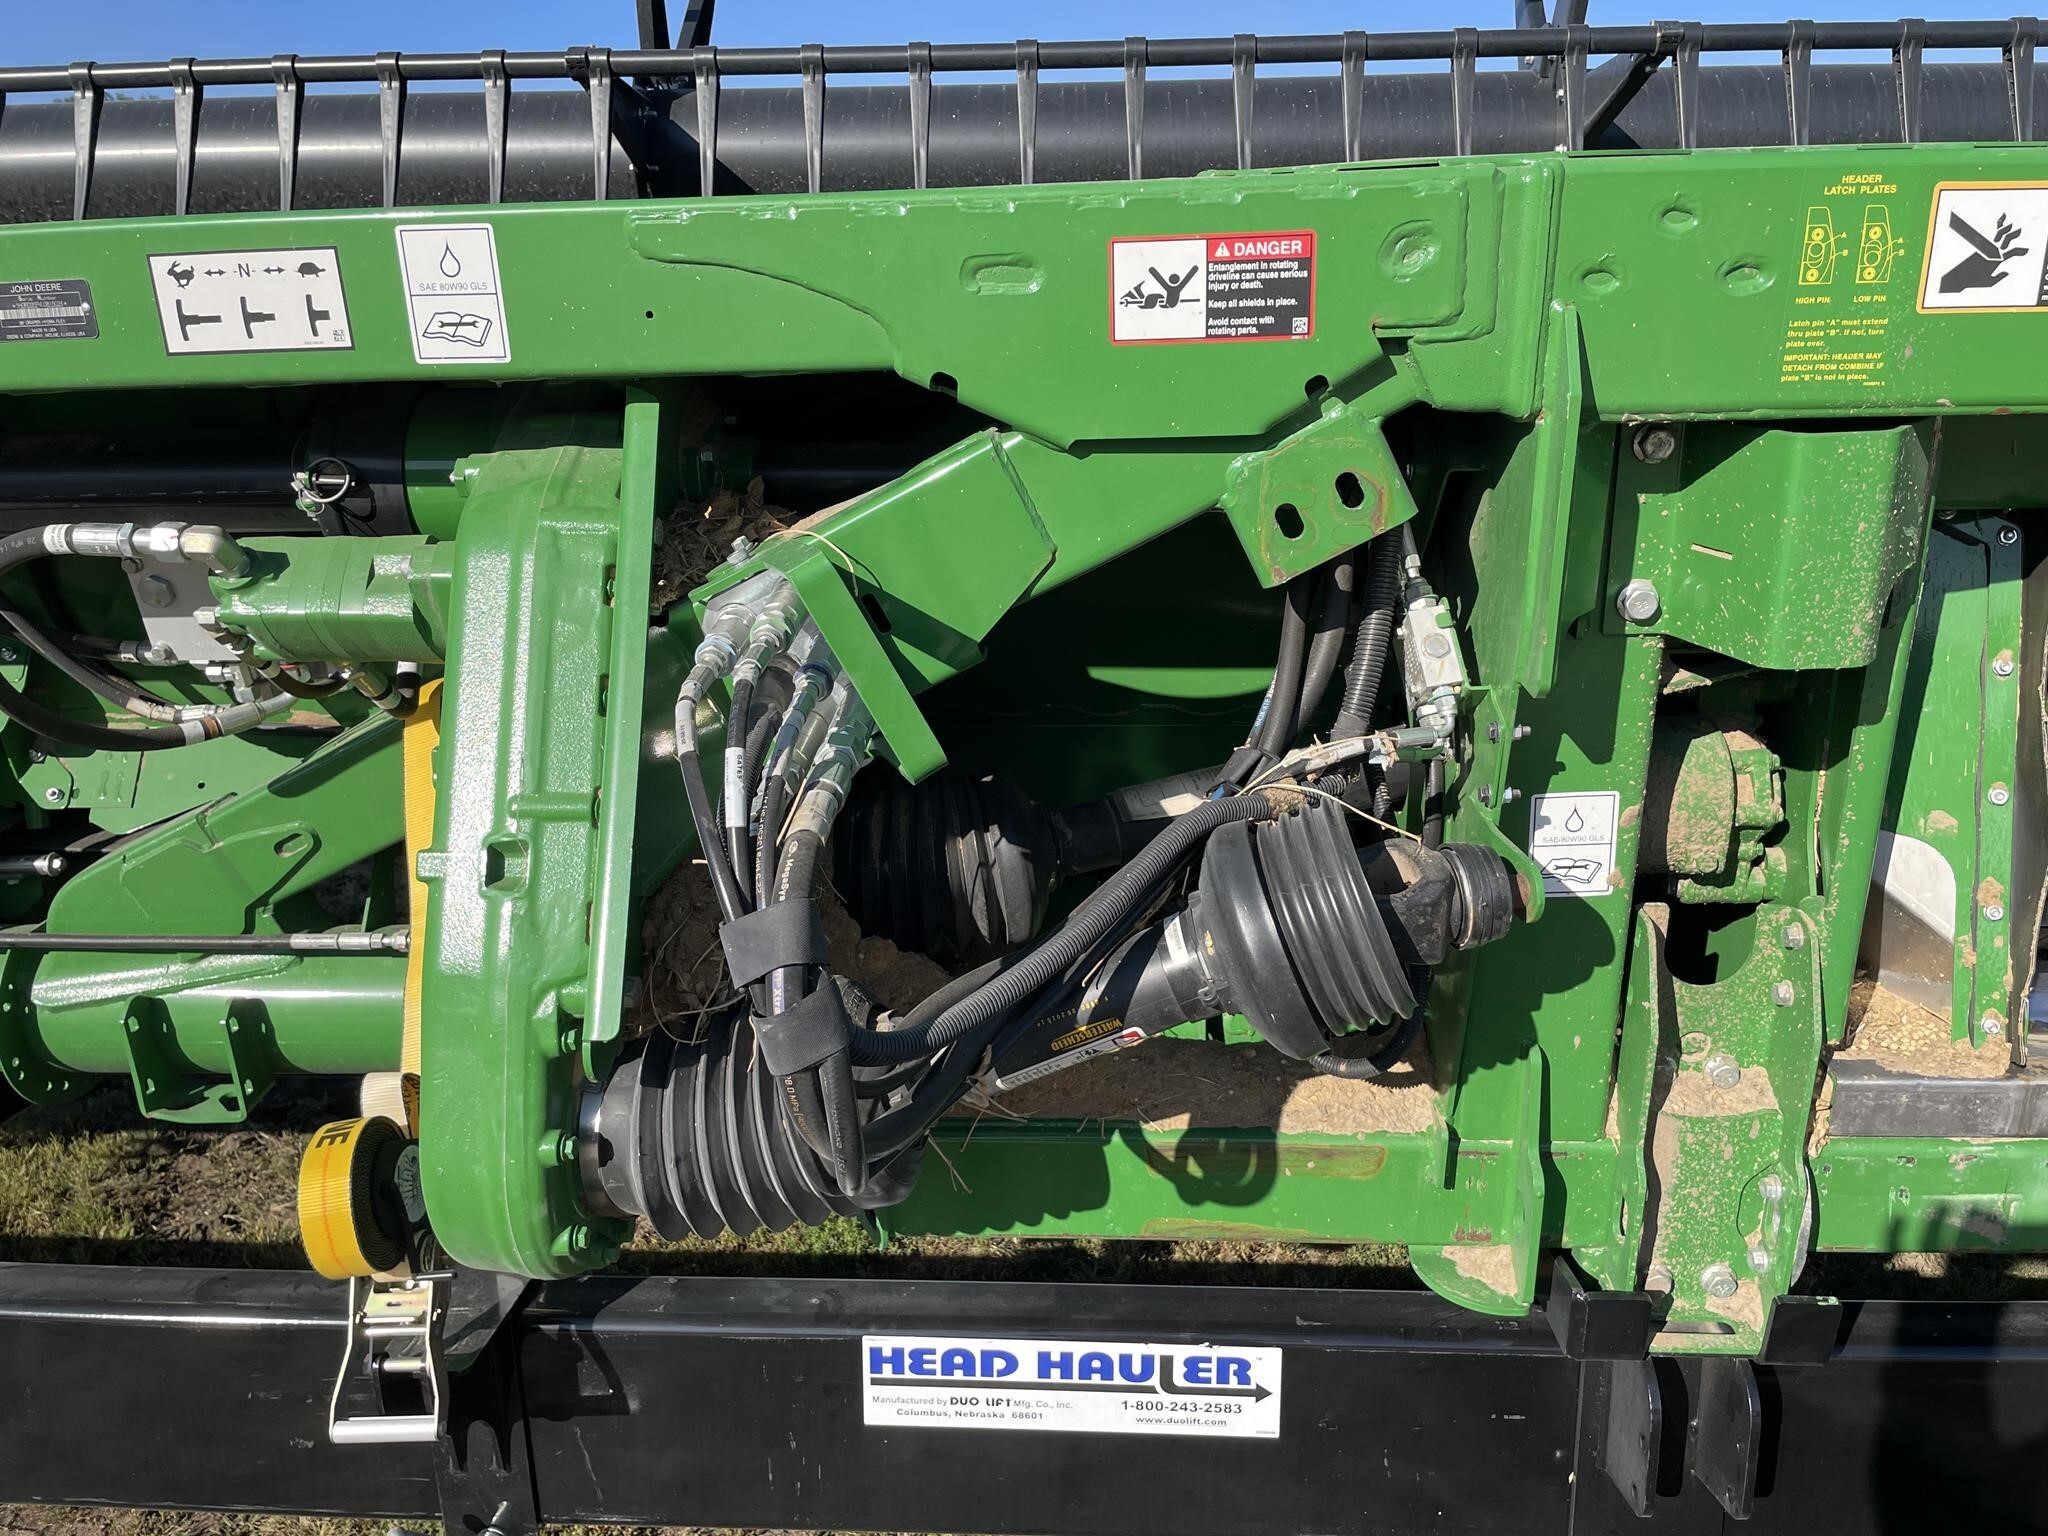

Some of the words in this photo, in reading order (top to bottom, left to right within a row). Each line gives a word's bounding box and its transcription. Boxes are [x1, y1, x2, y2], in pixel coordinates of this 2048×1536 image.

[1841, 174, 1883, 184] HEADER
[1824, 186, 1855, 195] LATCH
[1860, 185, 1897, 194] PLATES
[1234, 240, 1302, 256] DANGER
[1208, 262, 1259, 272] Entanglement
[1260, 261, 1268, 270] in
[1269, 260, 1298, 270] rotating
[1208, 273, 1240, 281] driveline
[1280, 270, 1308, 278] serious
[10, 285, 33, 293] JOHN
[35, 283, 62, 291] DEERE
[419, 283, 437, 291] SAE
[440, 282, 468, 291] 80W90
[470, 282, 487, 290] GL5
[1208, 282, 1229, 292] injury
[1230, 282, 1239, 290] or
[1240, 281, 1263, 289] death.
[1208, 300, 1227, 309] Keep
[1228, 299, 1237, 307] all
[1238, 298, 1265, 307] shields
[1266, 297, 1274, 306] in
[1275, 297, 1298, 307] place.
[1853, 295, 1871, 303] LOW
[1208, 317, 1229, 326] Avoid
[1230, 317, 1258, 325] contact
[1259, 316, 1275, 324] with
[1812, 320, 1825, 328] pin
[1208, 327, 1235, 336] rotating
[1237, 326, 1258, 336] parts.
[1804, 330, 1825, 338] plate
[1785, 340, 1805, 349] plate
[1782, 364, 1813, 372] DETACH
[1781, 375, 1799, 383] plate
[1846, 373, 1869, 381] place.
[1051, 1018, 1123, 1052] WALTERSCHEID
[869, 1346, 1019, 1378] HEAD
[1037, 1351, 1251, 1386] HAULER
[872, 1395, 934, 1406] Manufactured
[936, 1397, 948, 1407] by
[950, 1397, 980, 1406] DUO
[1013, 1399, 1033, 1409] Mfg.
[1036, 1400, 1054, 1409] Co.,
[1056, 1401, 1073, 1409] Inc.
[1121, 1400, 1242, 1414] 1-800-243-2583
[896, 1408, 952, 1419] Columbus,
[955, 1410, 1005, 1419] Nebraska
[1011, 1411, 1044, 1420] 68601
[1136, 1416, 1227, 1426] www.duolift.com
